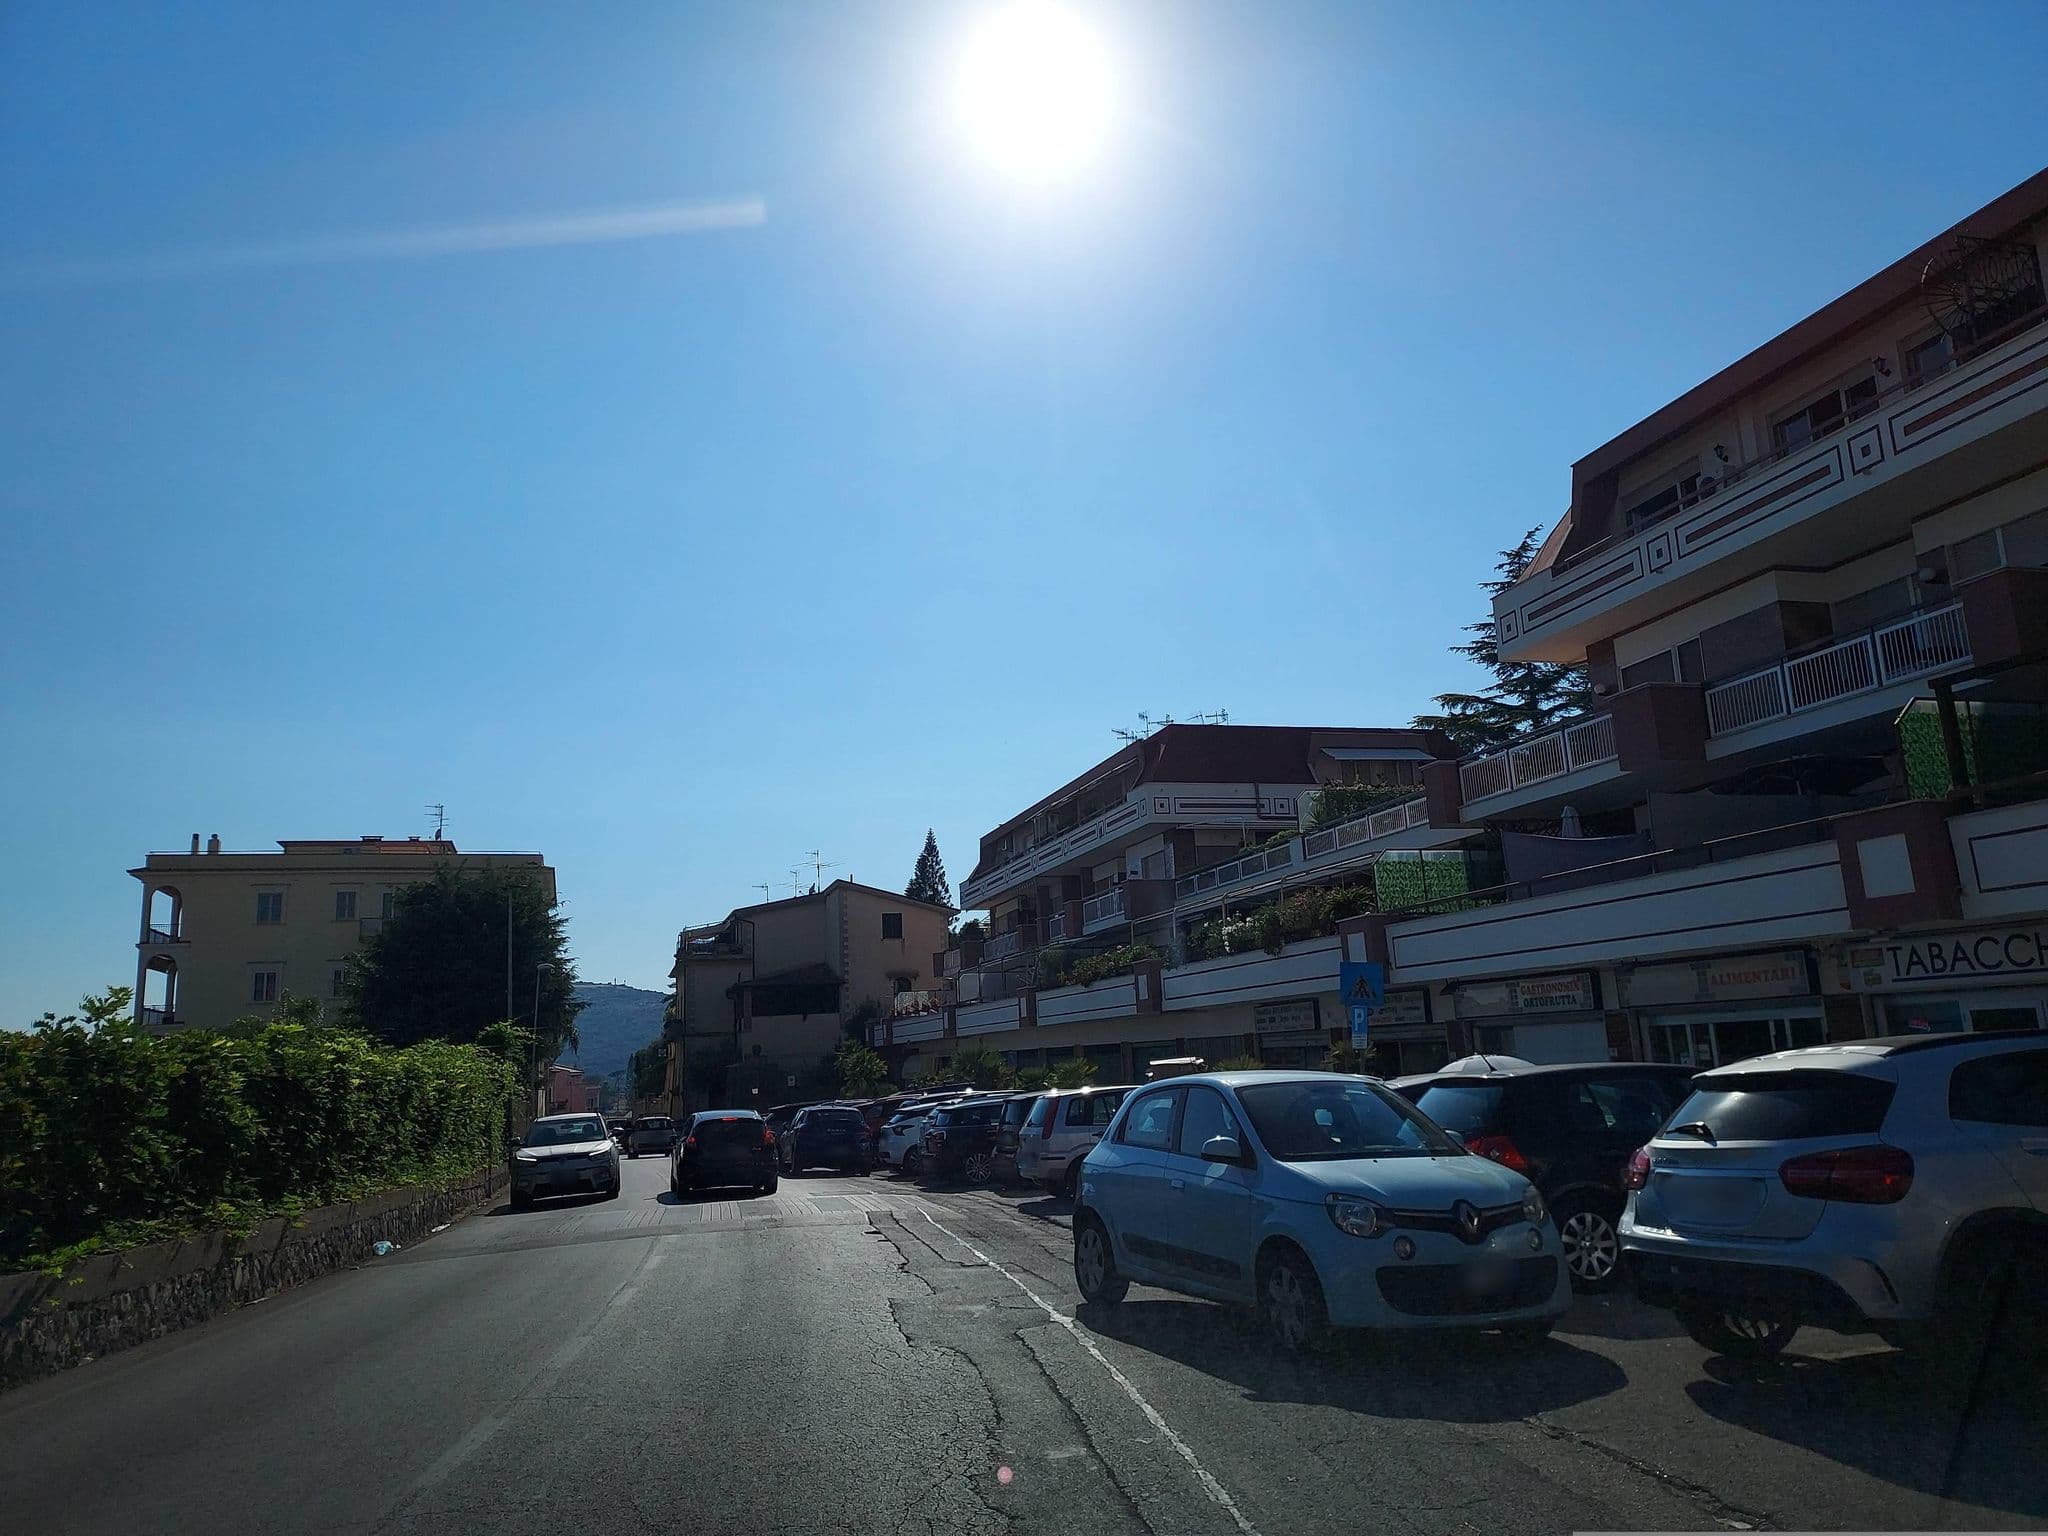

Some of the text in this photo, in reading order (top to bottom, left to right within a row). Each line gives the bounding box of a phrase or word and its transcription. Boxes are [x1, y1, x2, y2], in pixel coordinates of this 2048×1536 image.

[1711, 966, 1795, 986] ALIMENTARI
[1523, 994, 1577, 1008] ORTOFRUTTA
[1354, 1007, 1366, 1032] P
